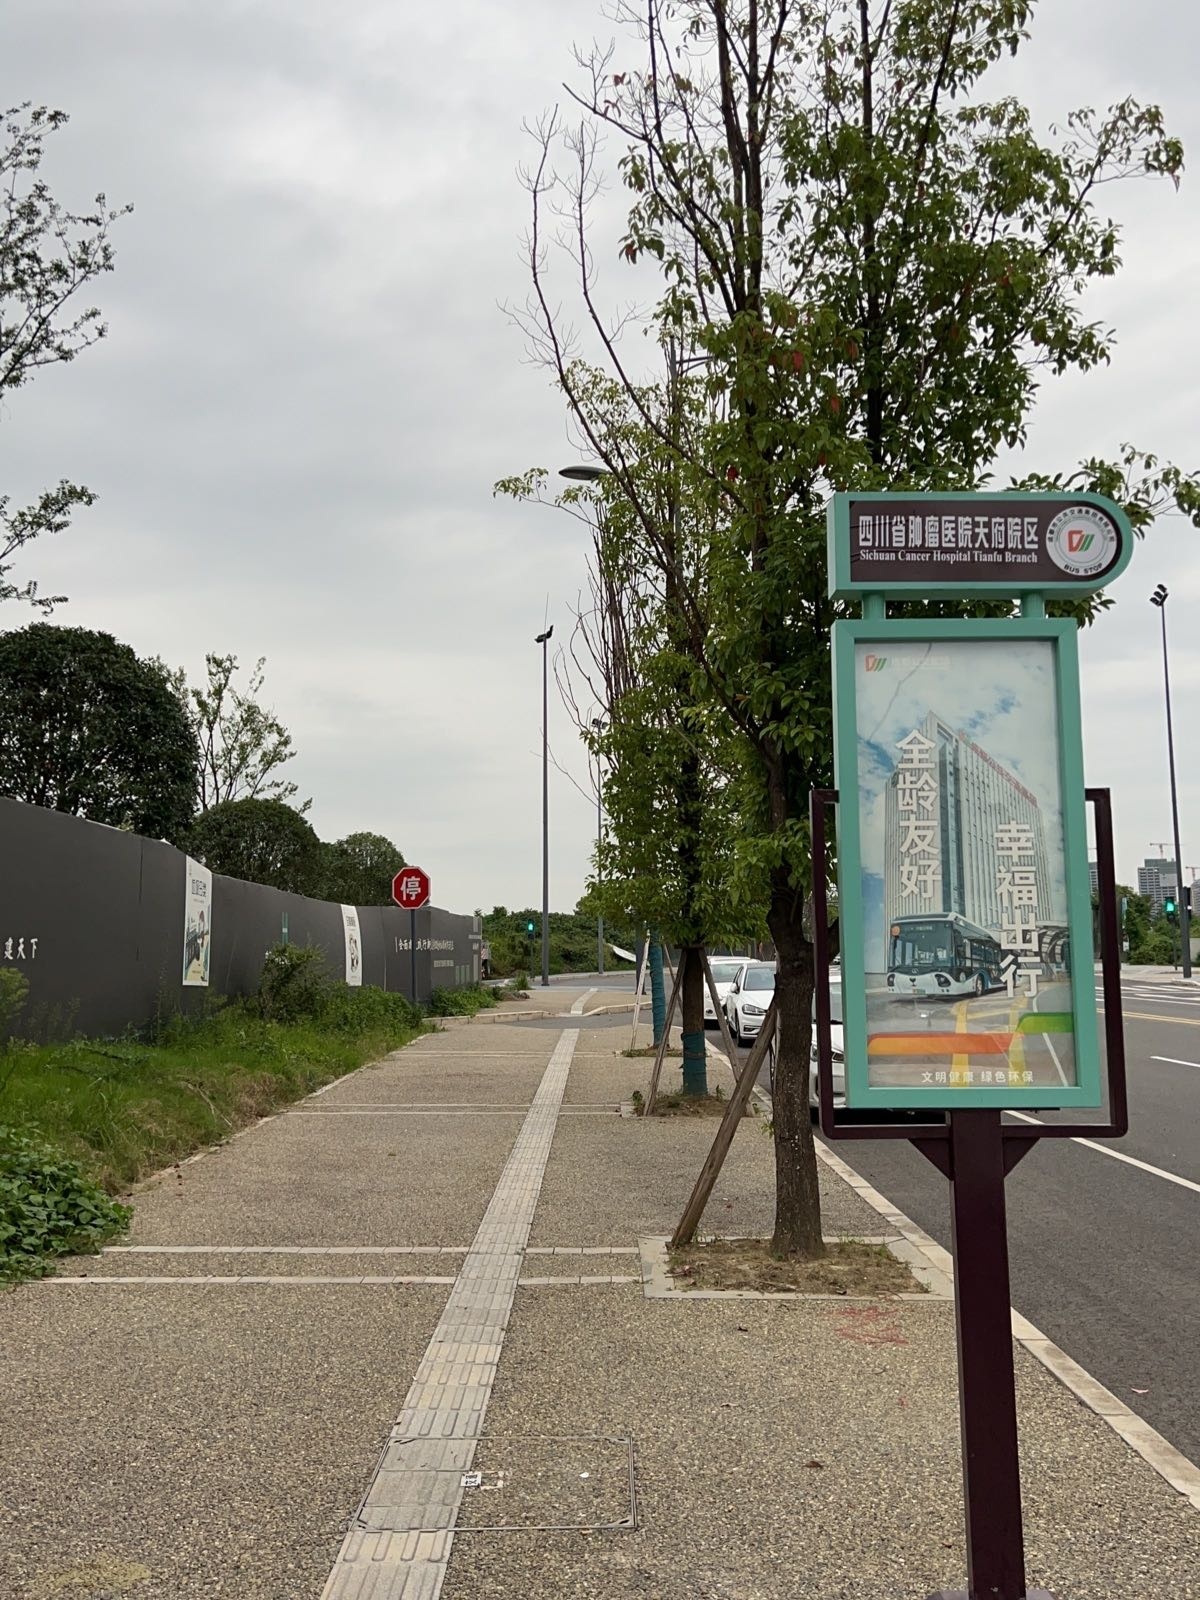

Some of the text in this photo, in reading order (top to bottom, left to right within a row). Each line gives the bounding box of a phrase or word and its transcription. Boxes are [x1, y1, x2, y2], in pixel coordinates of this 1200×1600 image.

[858, 514, 1039, 549] 四川省肿瘤医院天府院区
[859, 549, 1038, 565] Sichuan Cancer Hospital Tianfu Branch
[1063, 562, 1103, 574] BUS STOP
[896, 729, 942, 898] 全龄友好
[400, 875, 421, 901] 停
[994, 820, 1042, 998] 幸福出行
[921, 1071, 1034, 1083] 文明健康 绿色环保
